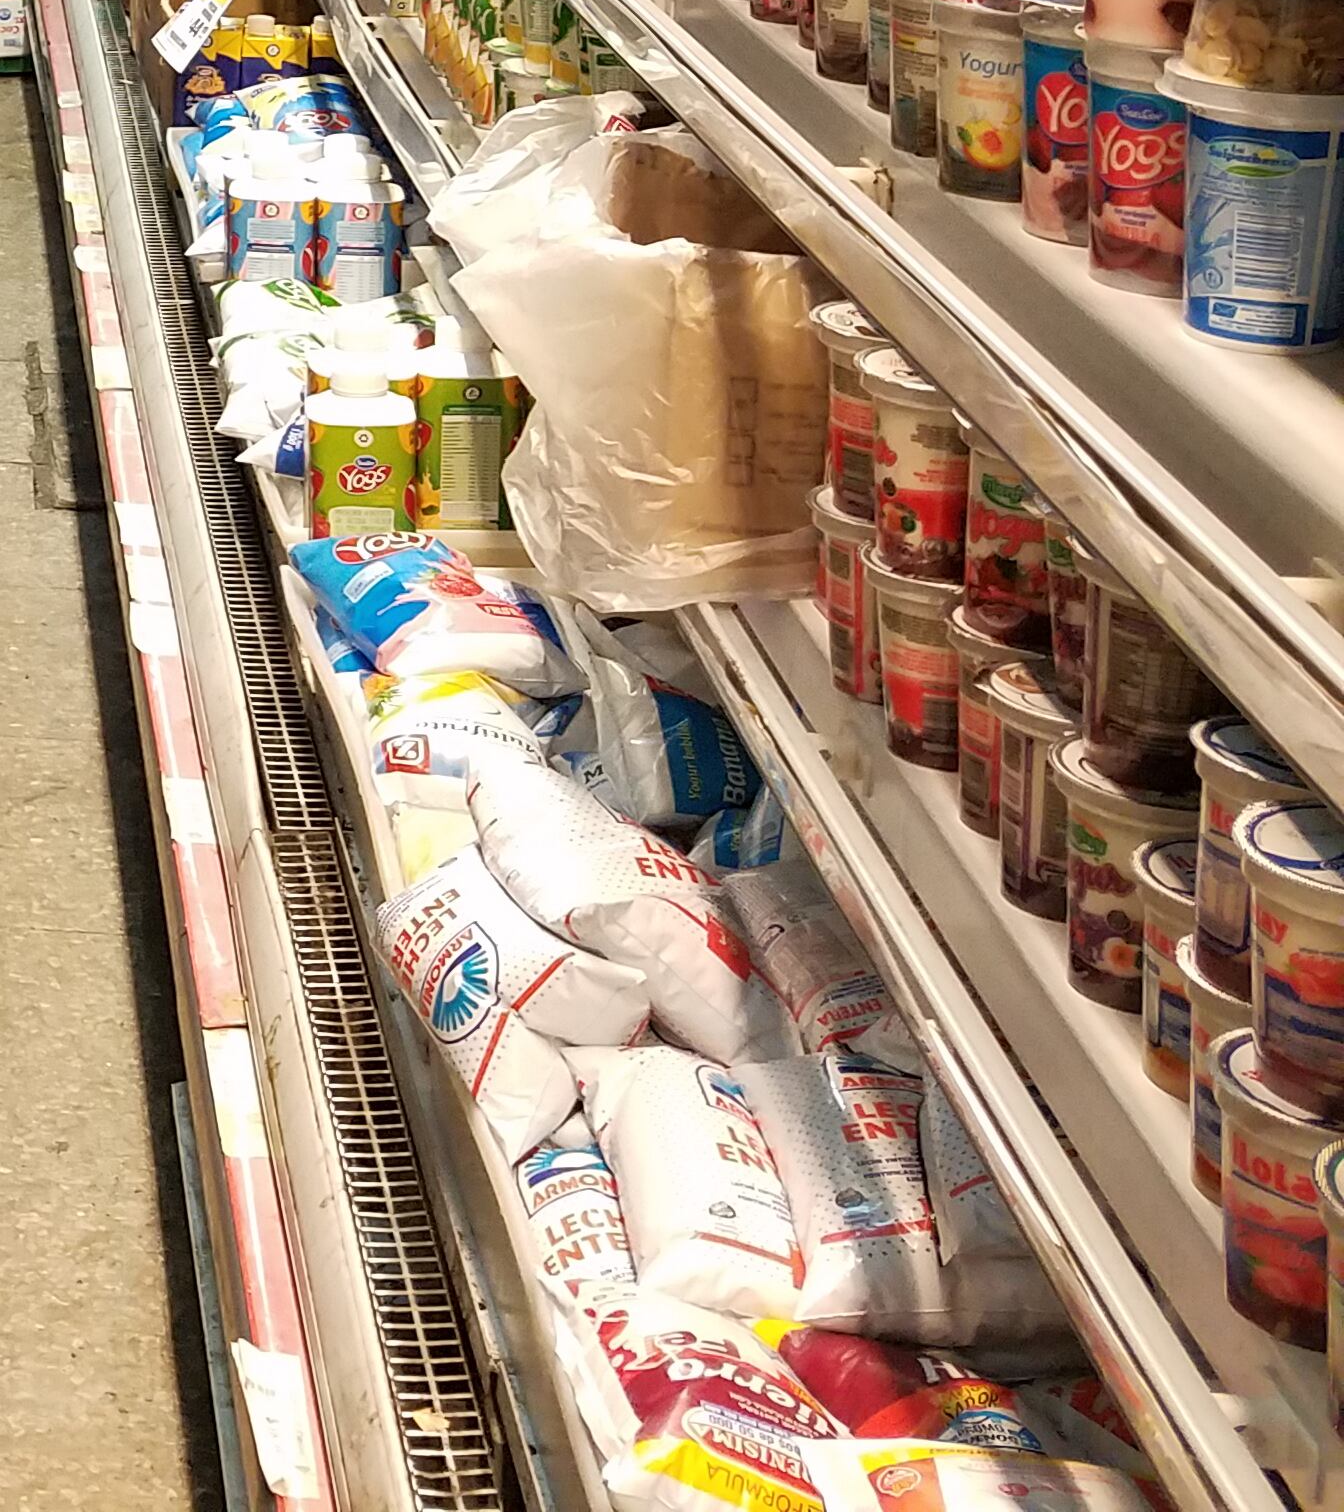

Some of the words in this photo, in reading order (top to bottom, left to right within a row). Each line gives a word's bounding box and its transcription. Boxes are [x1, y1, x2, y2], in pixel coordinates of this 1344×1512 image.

[959, 51, 1023, 77] Yogur
[1095, 124, 1187, 180] Yogs
[342, 465, 389, 492] Yogs
[391, 888, 460, 969] ENTER
[817, 998, 882, 1026] ENTERA
[532, 1174, 618, 1208] ARMON
[545, 1209, 624, 1247] LECH
[543, 1232, 630, 1276] ENTE
[691, 1423, 809, 1479] ENISIMA
